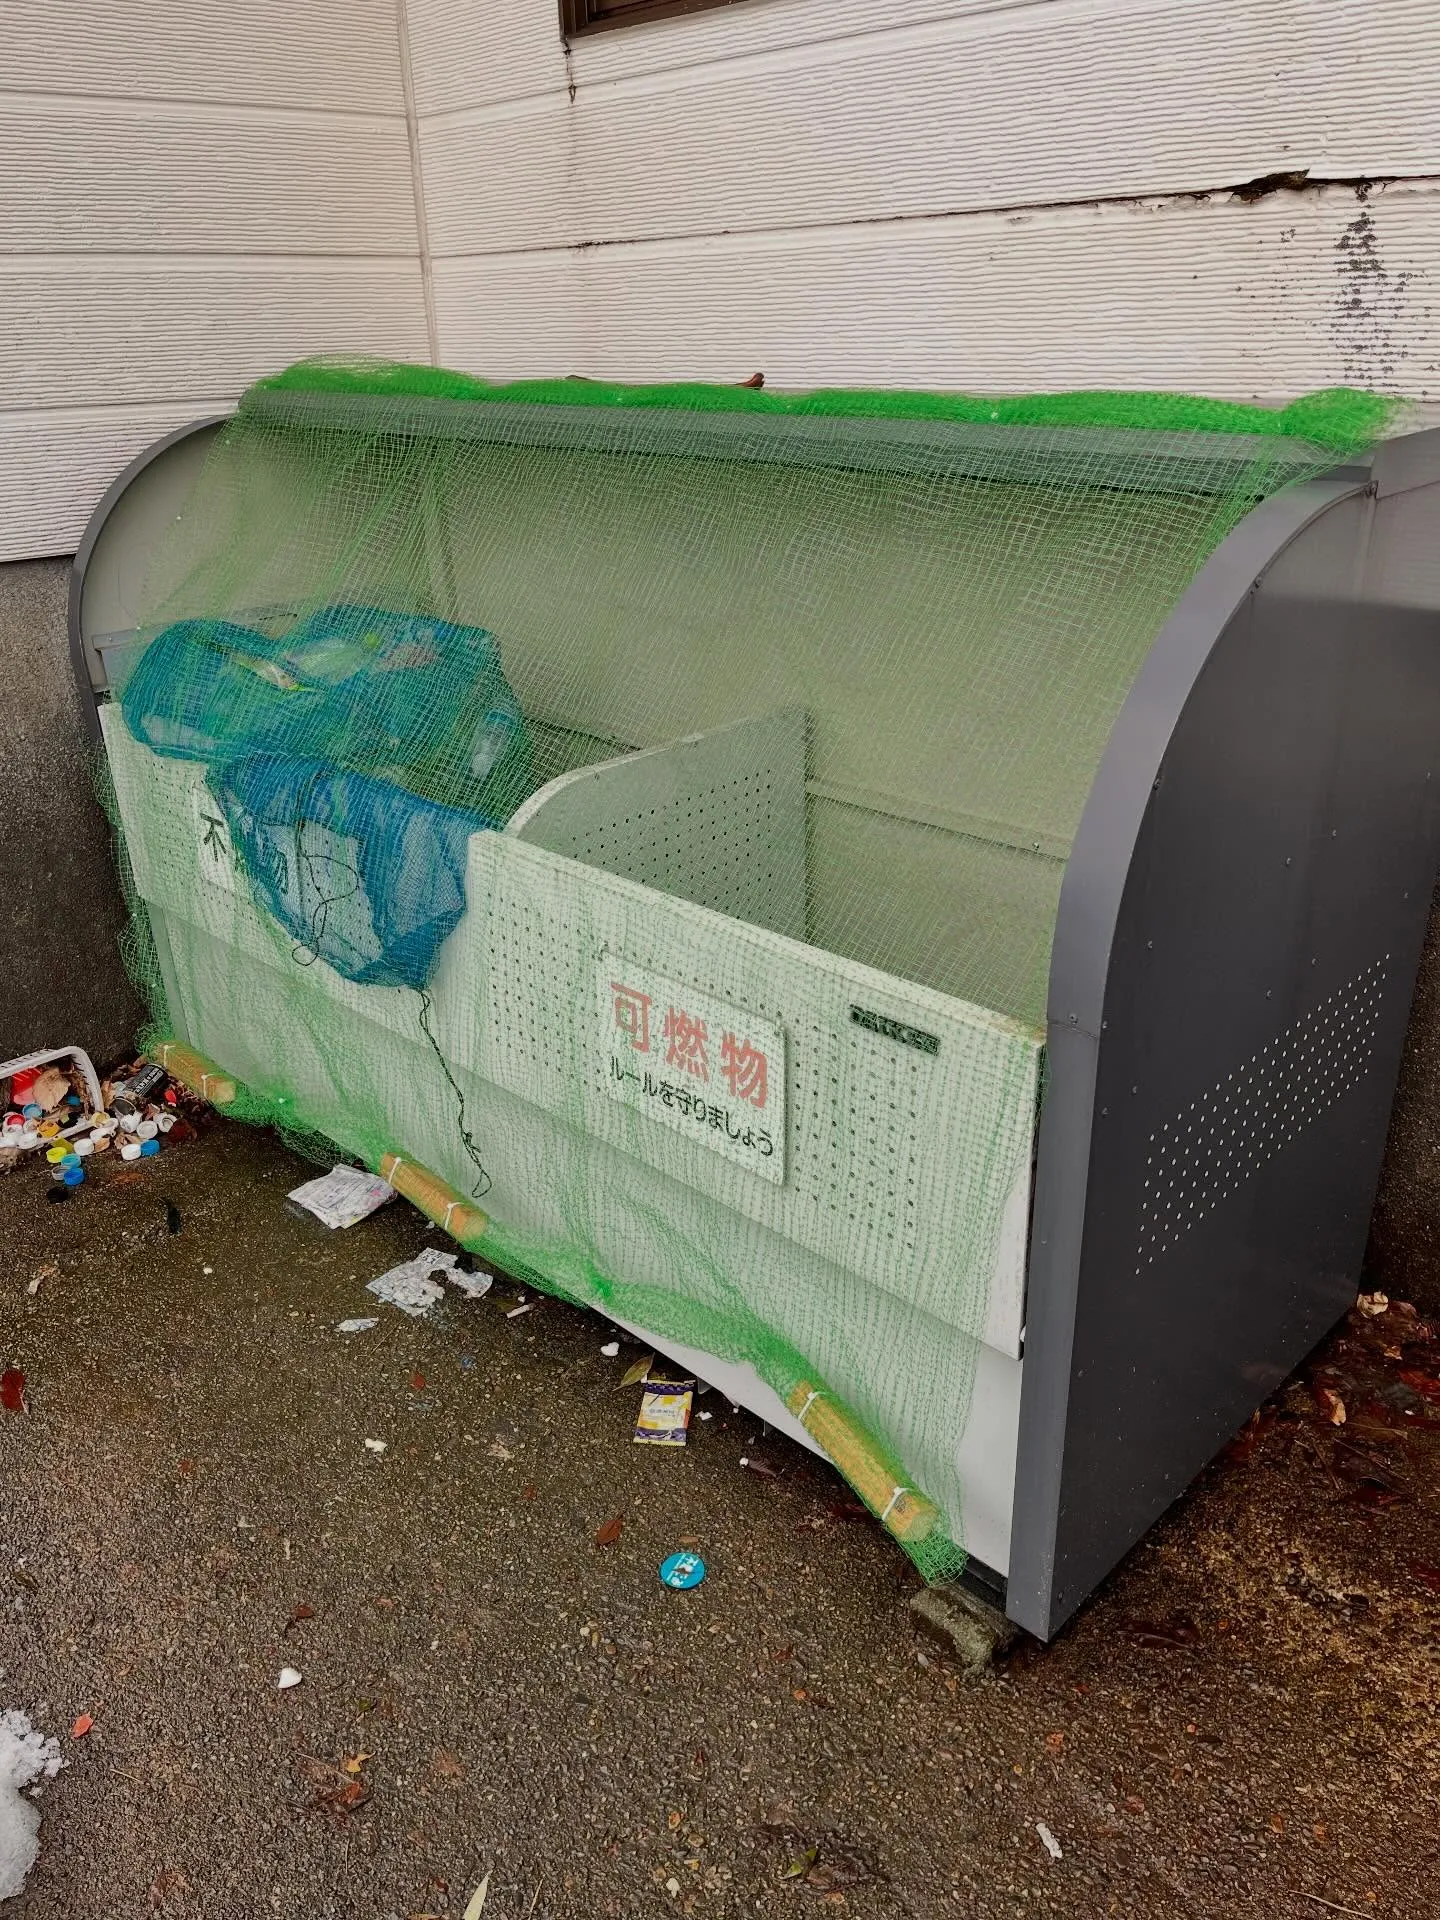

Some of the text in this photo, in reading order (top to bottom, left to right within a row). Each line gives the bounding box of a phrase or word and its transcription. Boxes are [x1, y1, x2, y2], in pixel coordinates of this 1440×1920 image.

[610, 981, 769, 1109] 可燃物
[610, 1055, 774, 1157] ルールを守りましょう
